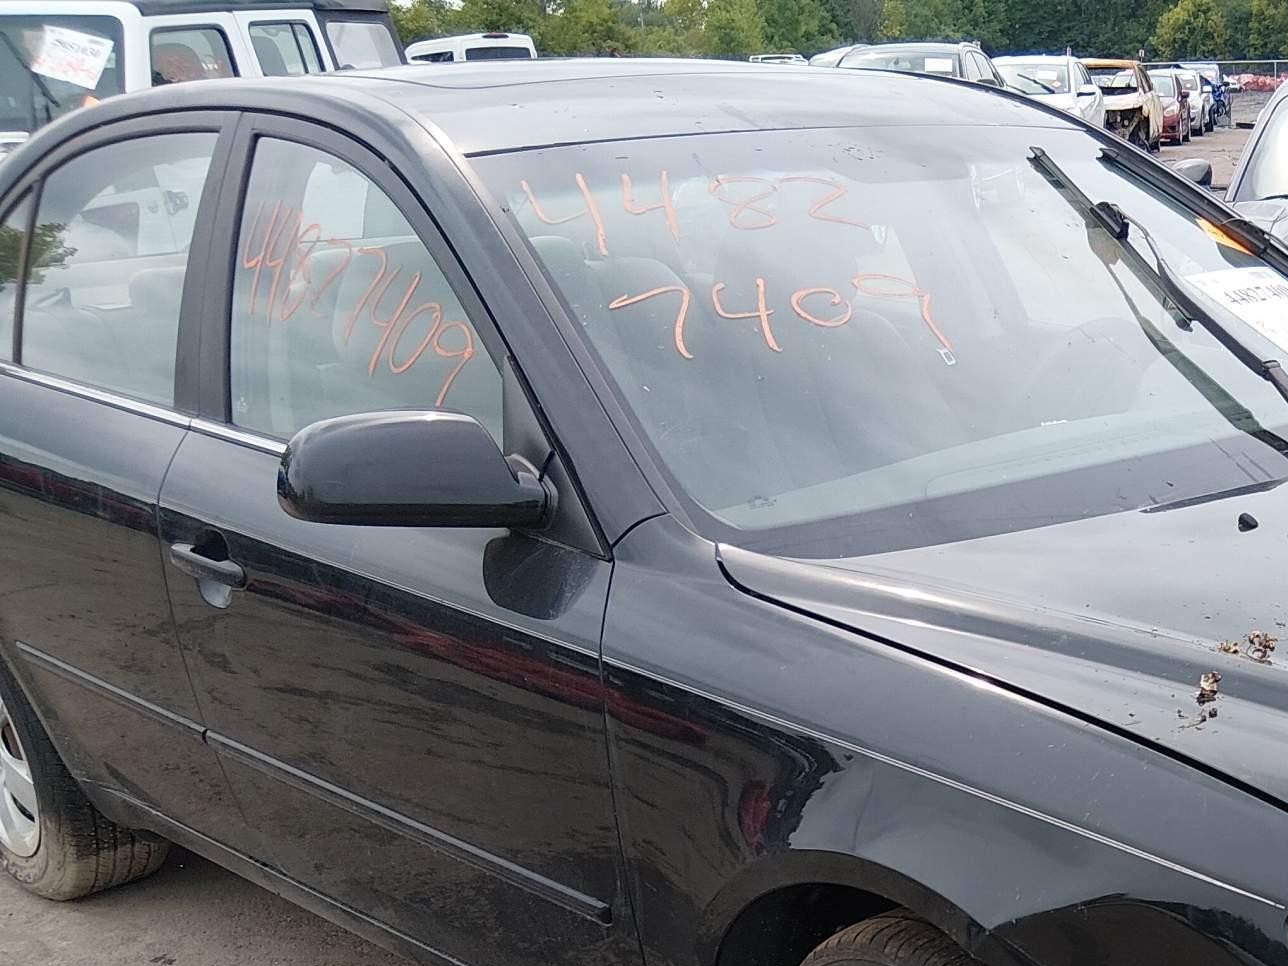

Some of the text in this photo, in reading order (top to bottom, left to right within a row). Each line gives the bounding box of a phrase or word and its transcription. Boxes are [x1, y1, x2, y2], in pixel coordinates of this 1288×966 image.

[519, 168, 869, 256] 4482
[243, 200, 475, 408] 44827409
[608, 274, 955, 360] 7409
